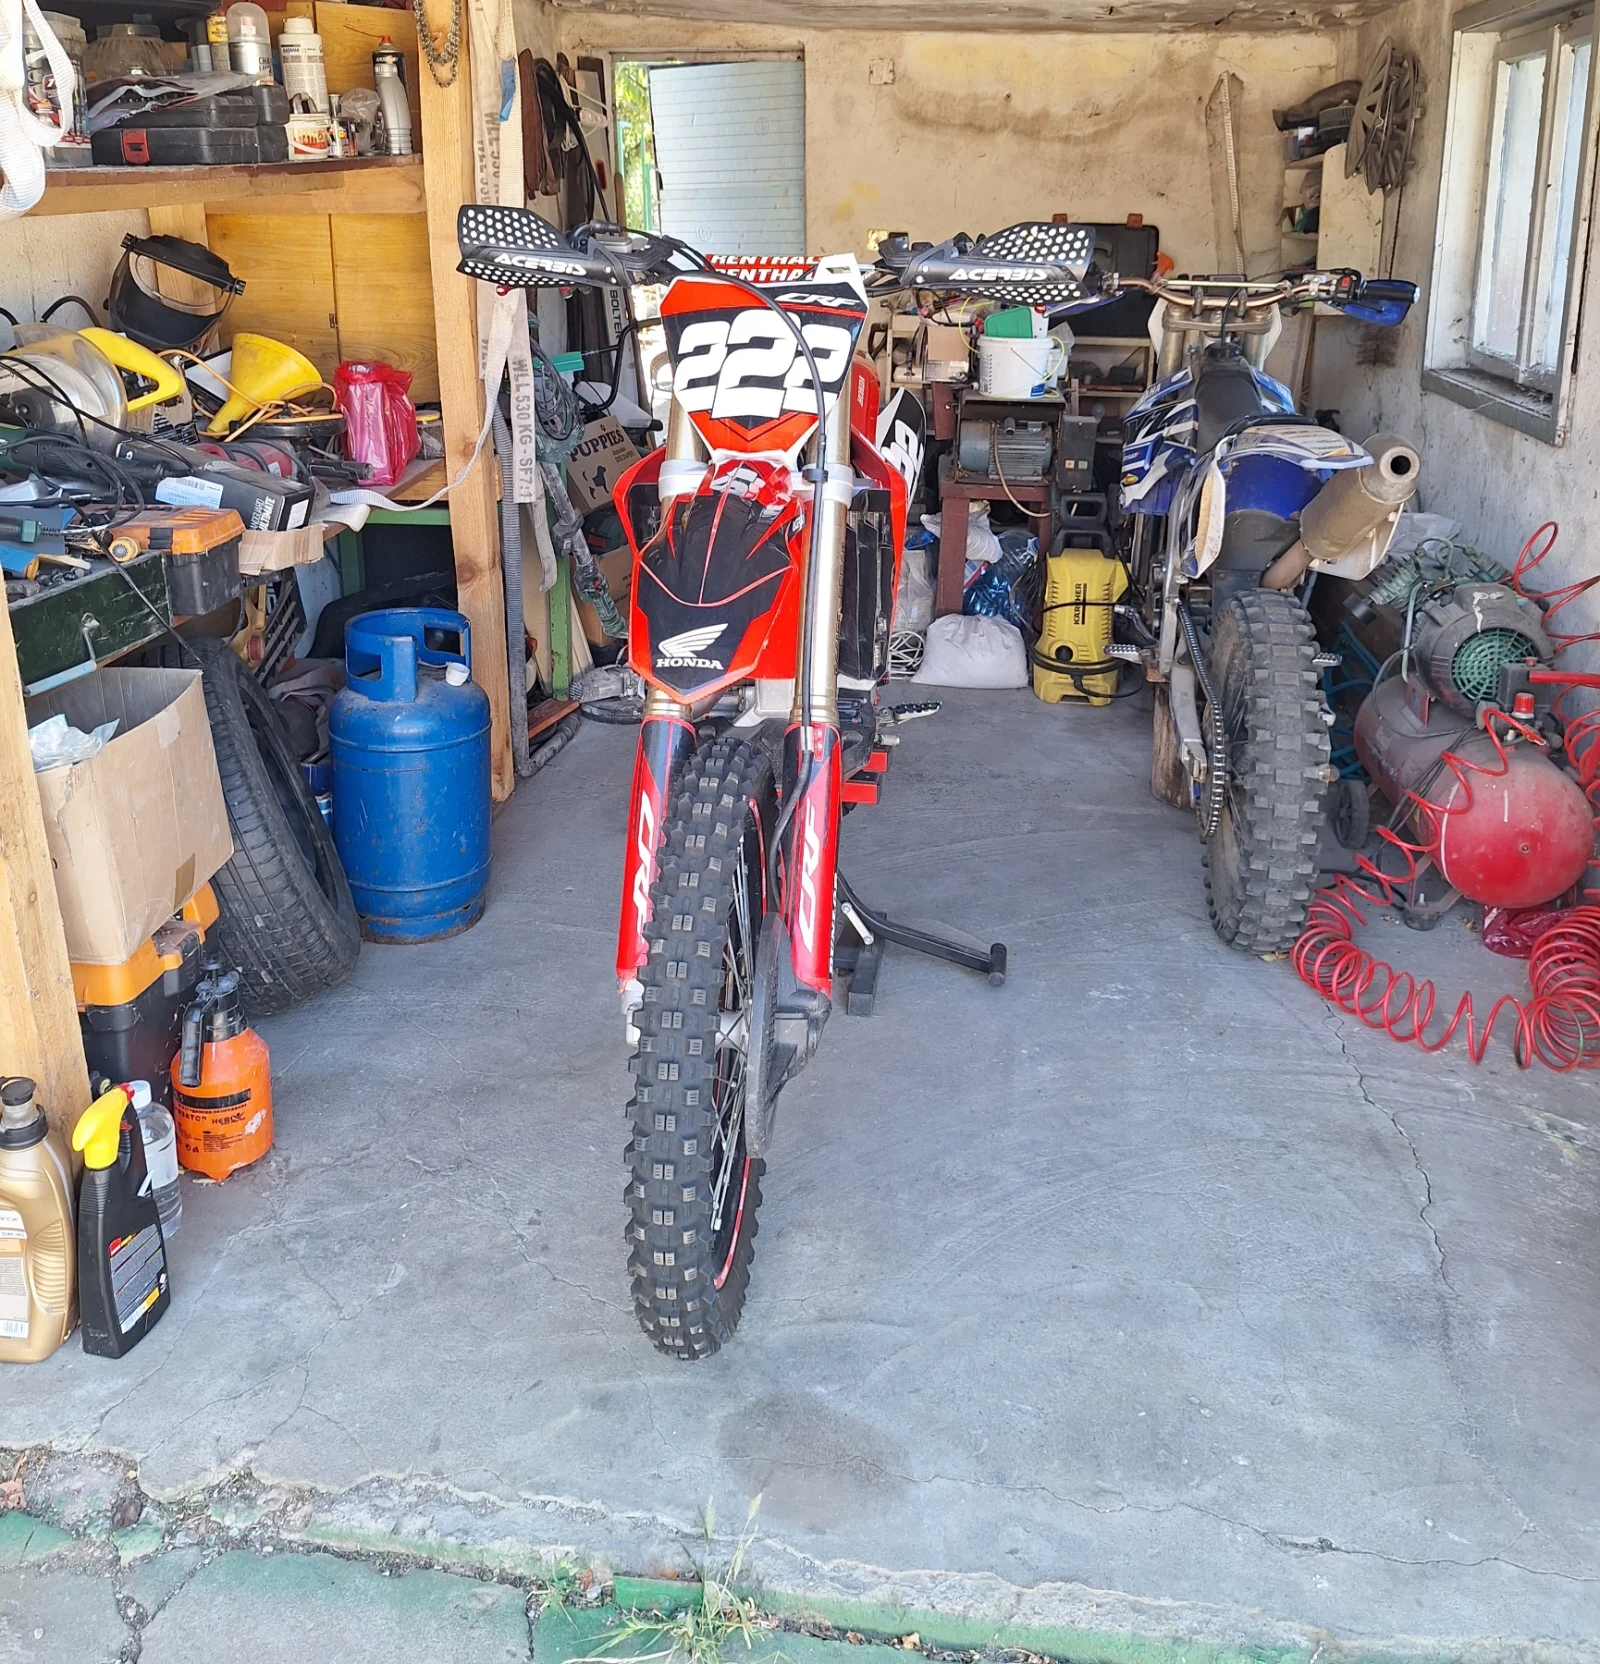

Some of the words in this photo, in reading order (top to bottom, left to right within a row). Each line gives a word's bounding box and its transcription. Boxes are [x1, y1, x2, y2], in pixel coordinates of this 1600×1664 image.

[494, 253, 587, 276] ACERBIS
[710, 254, 822, 265] RENTHAL
[949, 268, 1048, 281] ACERBIS
[774, 292, 861, 307] CRF
[512, 358, 529, 392] WLL
[673, 309, 852, 419] 222
[515, 395, 531, 420] 530
[518, 424, 533, 446] KG
[570, 429, 625, 462] PUPPIES
[258, 496, 276, 531] ULTIMATE
[655, 658, 724, 670] HONDA
[799, 797, 820, 953] CRF
